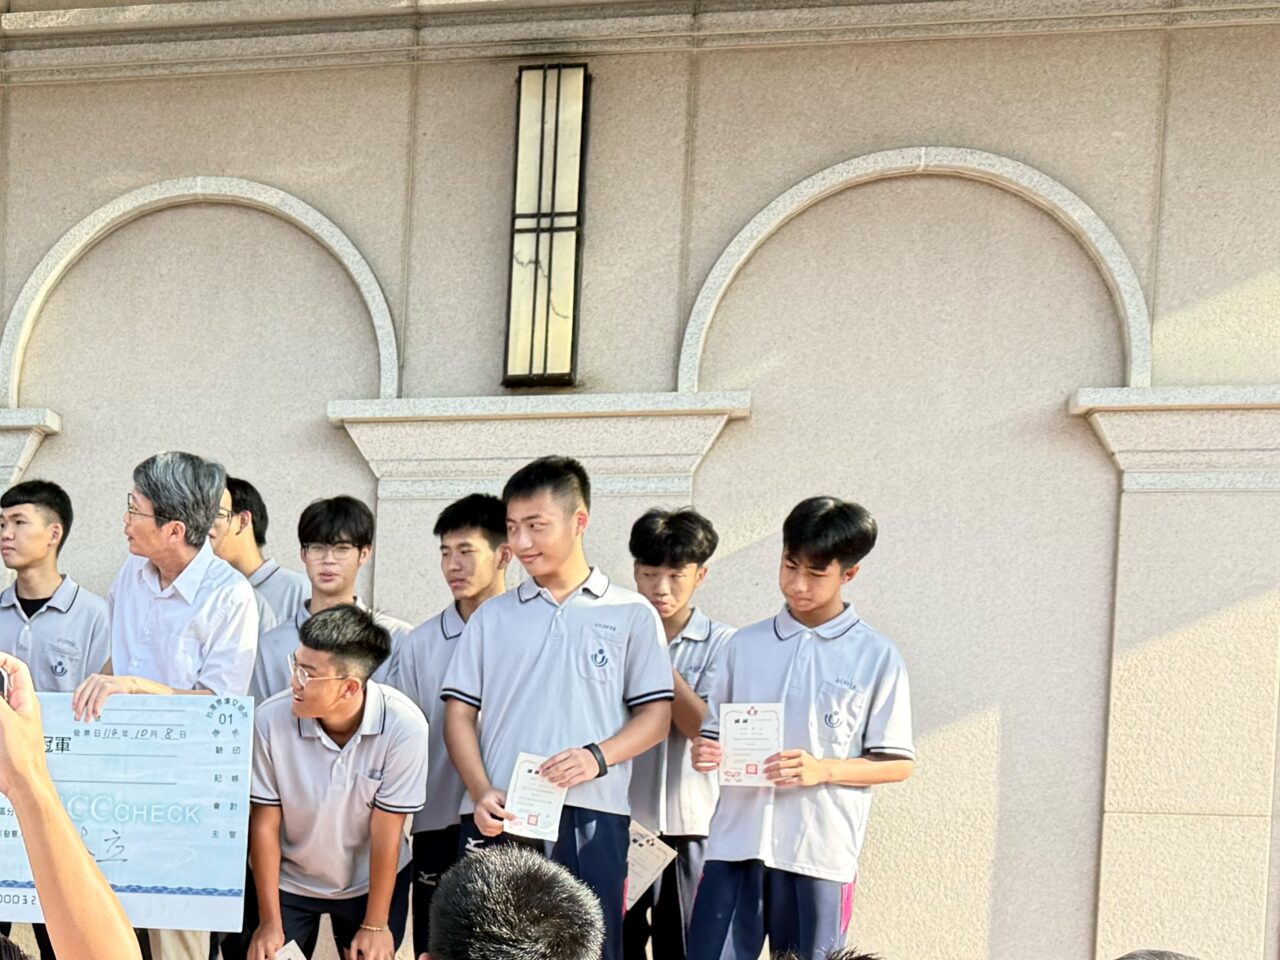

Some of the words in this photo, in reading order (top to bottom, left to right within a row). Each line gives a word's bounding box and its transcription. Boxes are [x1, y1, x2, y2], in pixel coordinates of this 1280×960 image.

[219, 713, 233, 725] 01
[44, 736, 71, 753] 冠軍
[114, 802, 200, 824] CHECK
